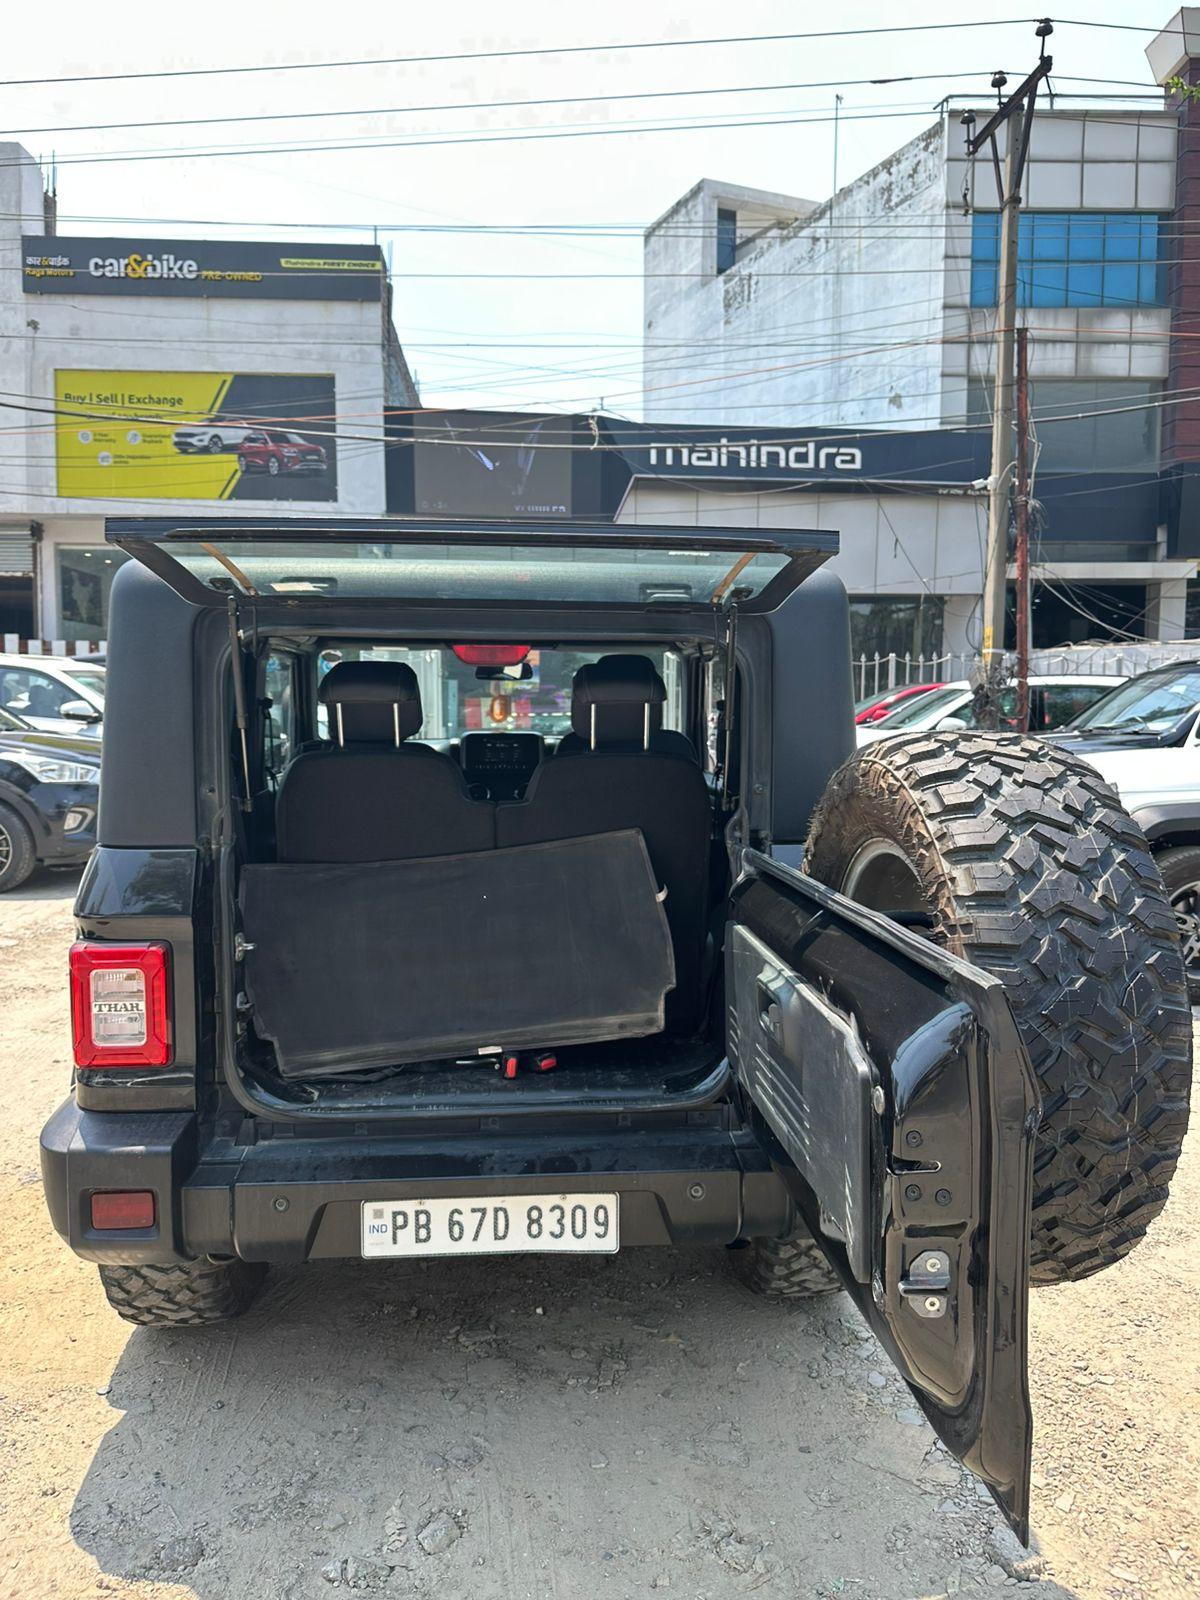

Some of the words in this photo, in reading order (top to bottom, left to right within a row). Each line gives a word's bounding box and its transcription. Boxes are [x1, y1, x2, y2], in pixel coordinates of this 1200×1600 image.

[88, 253, 198, 279] car&bike
[64, 392, 86, 404] Buy
[95, 393, 118, 404] Sell
[128, 394, 184, 406] Exchange
[650, 438, 862, 470] mahindra
[94, 1002, 144, 1013] THAR
[368, 1224, 388, 1234] IND
[391, 1209, 432, 1245] PB
[447, 1206, 510, 1242] 67D
[526, 1204, 609, 1240] 8309
